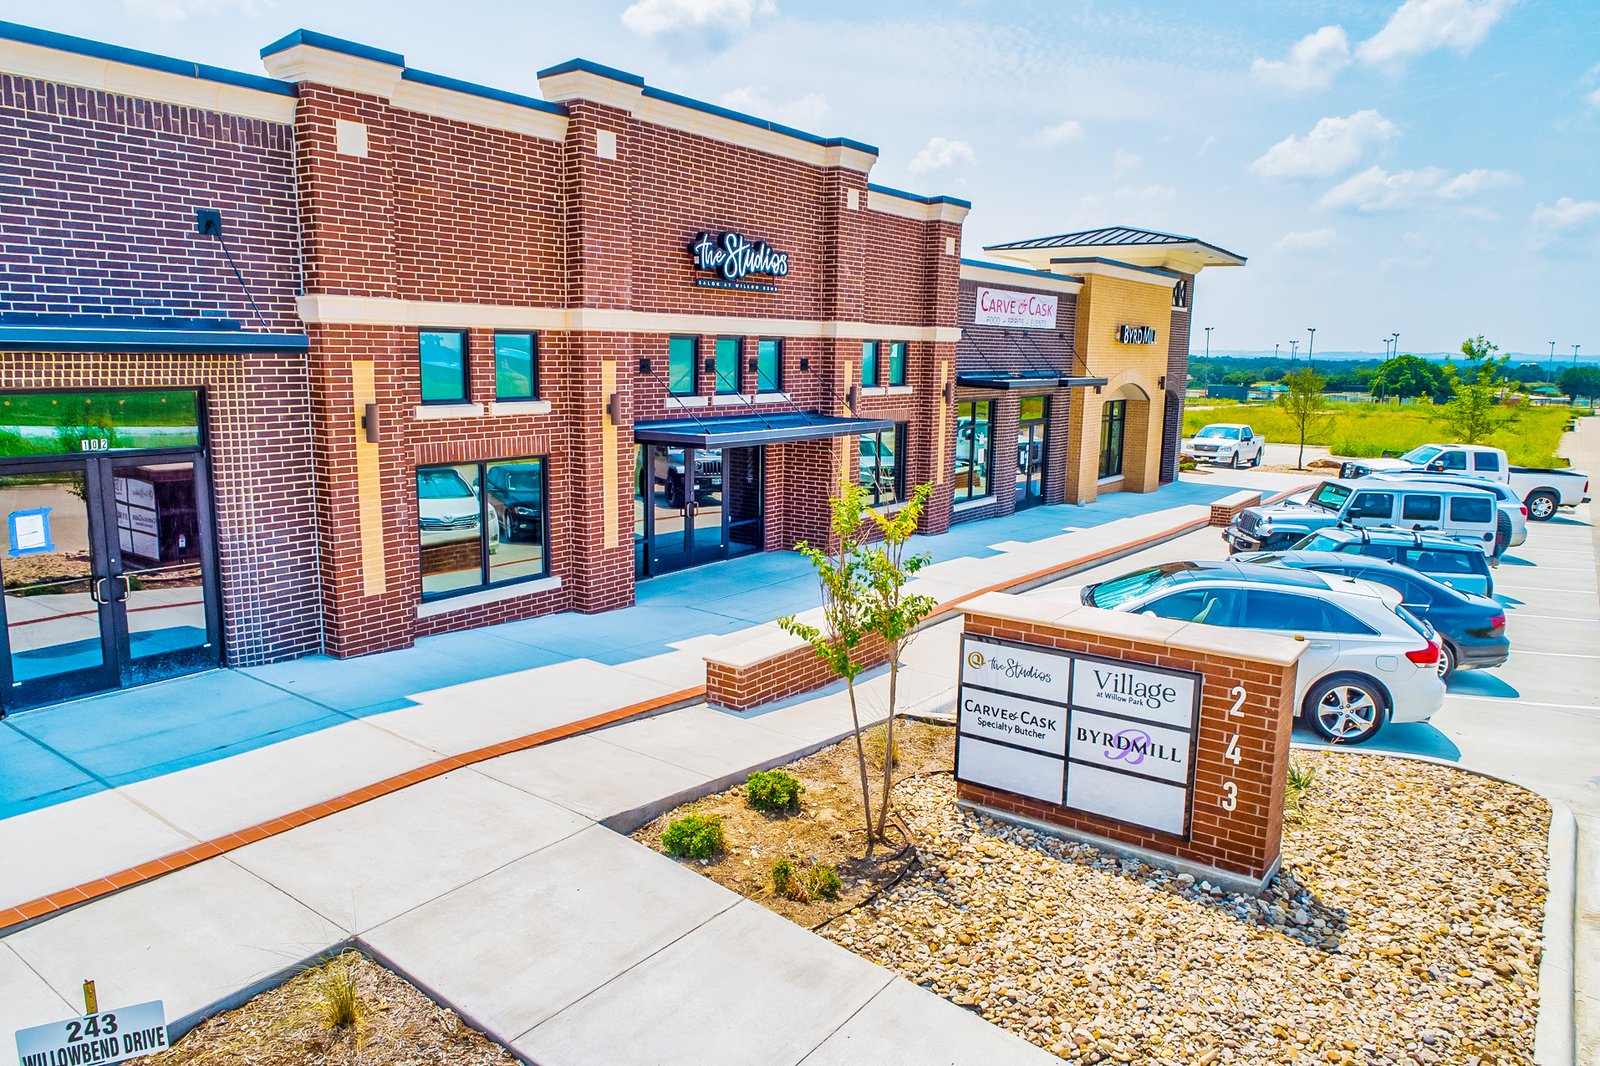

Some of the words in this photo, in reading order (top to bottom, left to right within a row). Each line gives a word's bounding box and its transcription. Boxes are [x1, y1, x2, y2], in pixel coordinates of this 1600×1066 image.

[695, 234, 726, 268] the
[724, 234, 788, 278] Studios
[981, 290, 1016, 314] CARVE
[1029, 296, 1053, 316] CASK
[986, 316, 1000, 324] FOOD
[82, 439, 107, 450] 102
[988, 657, 1006, 671] the
[1005, 658, 1051, 683] Studios
[1093, 670, 1176, 709] Village
[1105, 692, 1126, 703] Willow
[1128, 697, 1143, 706] Park
[977, 717, 1013, 734] Specialty
[1015, 725, 1046, 739] Butcher
[66, 1013, 117, 1043] 243
[123, 1026, 166, 1054] DRIVE
